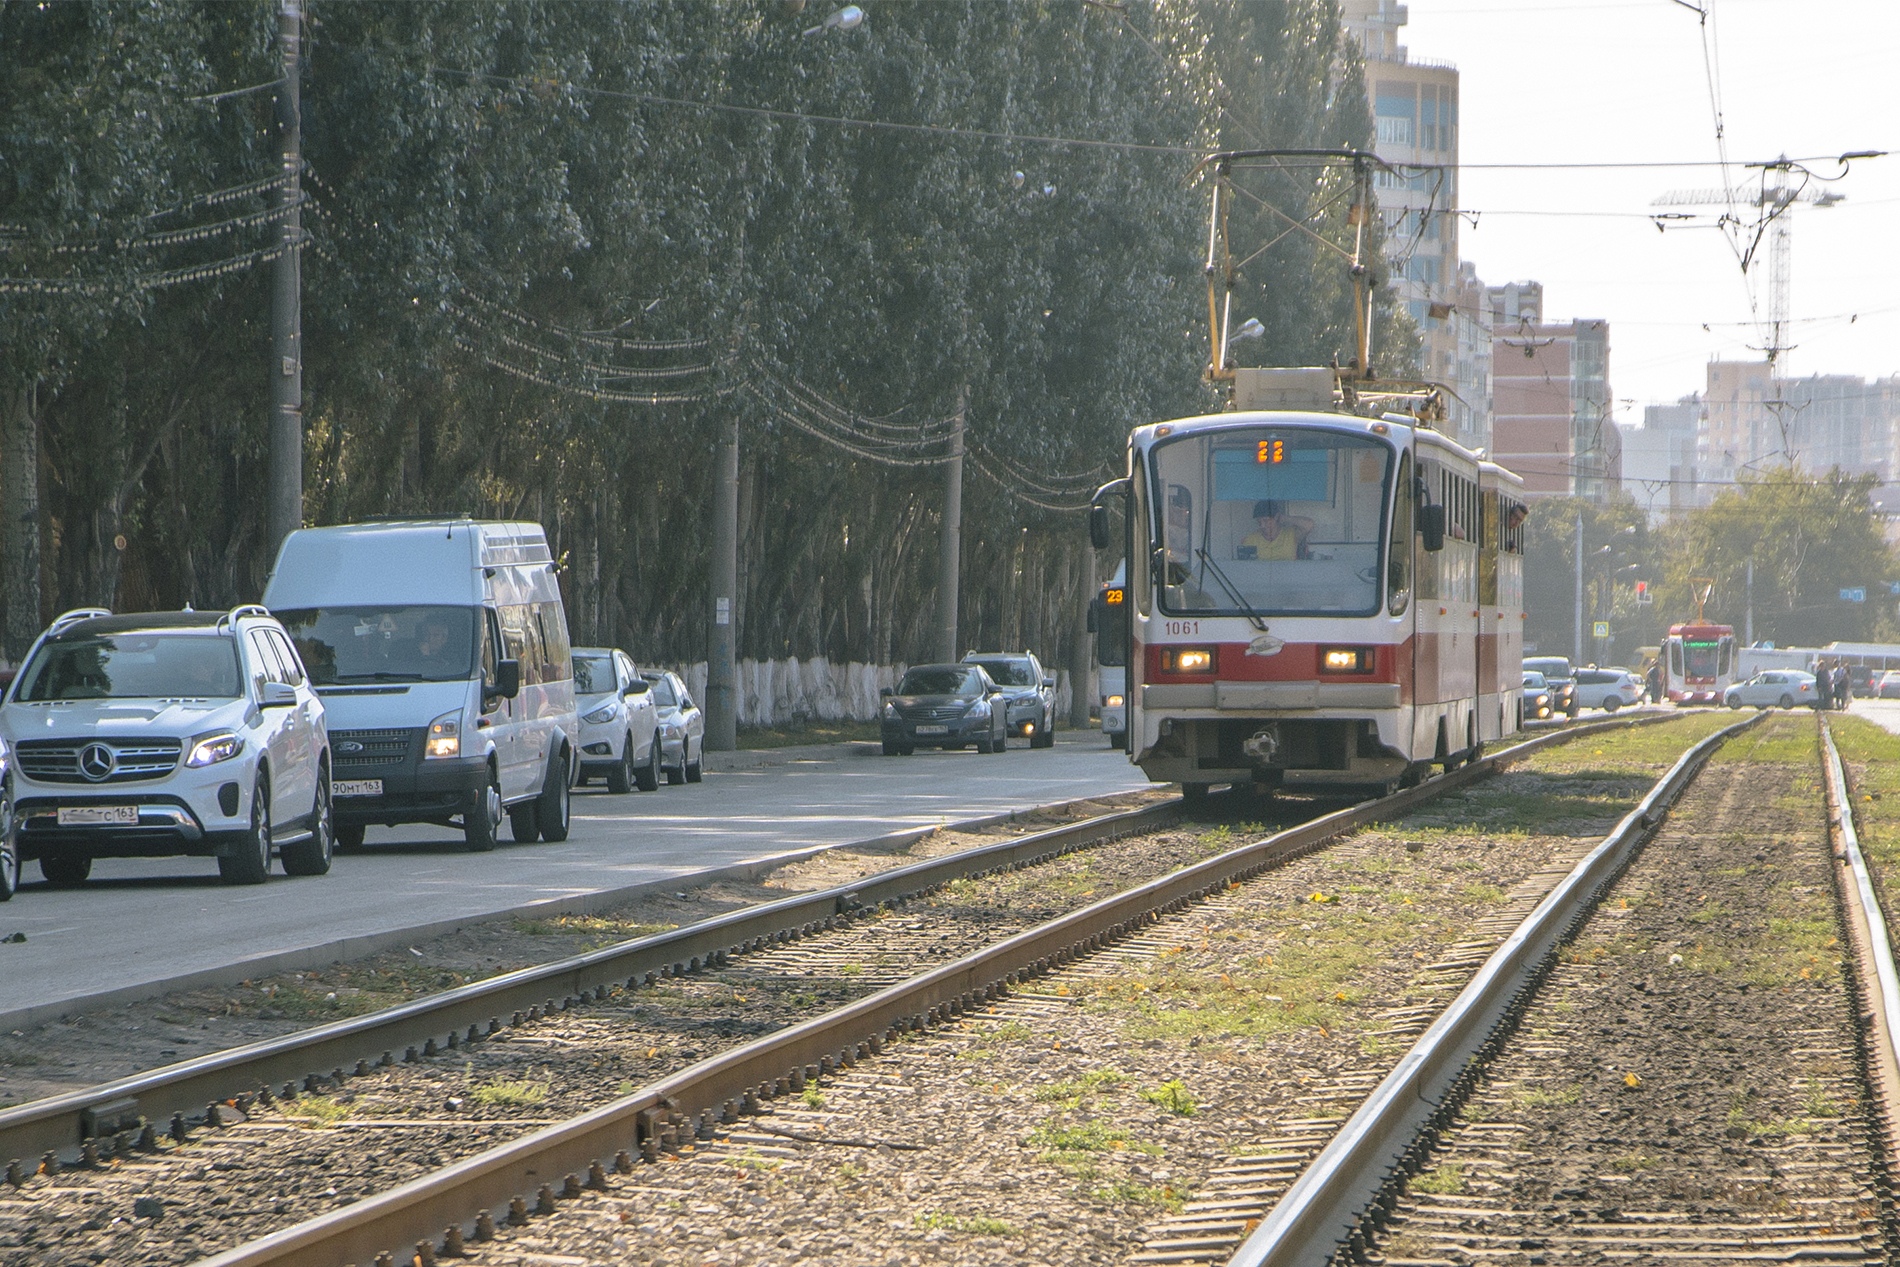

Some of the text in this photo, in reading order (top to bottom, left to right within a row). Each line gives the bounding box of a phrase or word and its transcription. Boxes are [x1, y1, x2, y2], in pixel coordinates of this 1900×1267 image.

[1107, 590, 1123, 603] 23
[1165, 621, 1200, 635] 1061
[363, 781, 380, 790] 163
[114, 807, 134, 818] 163
